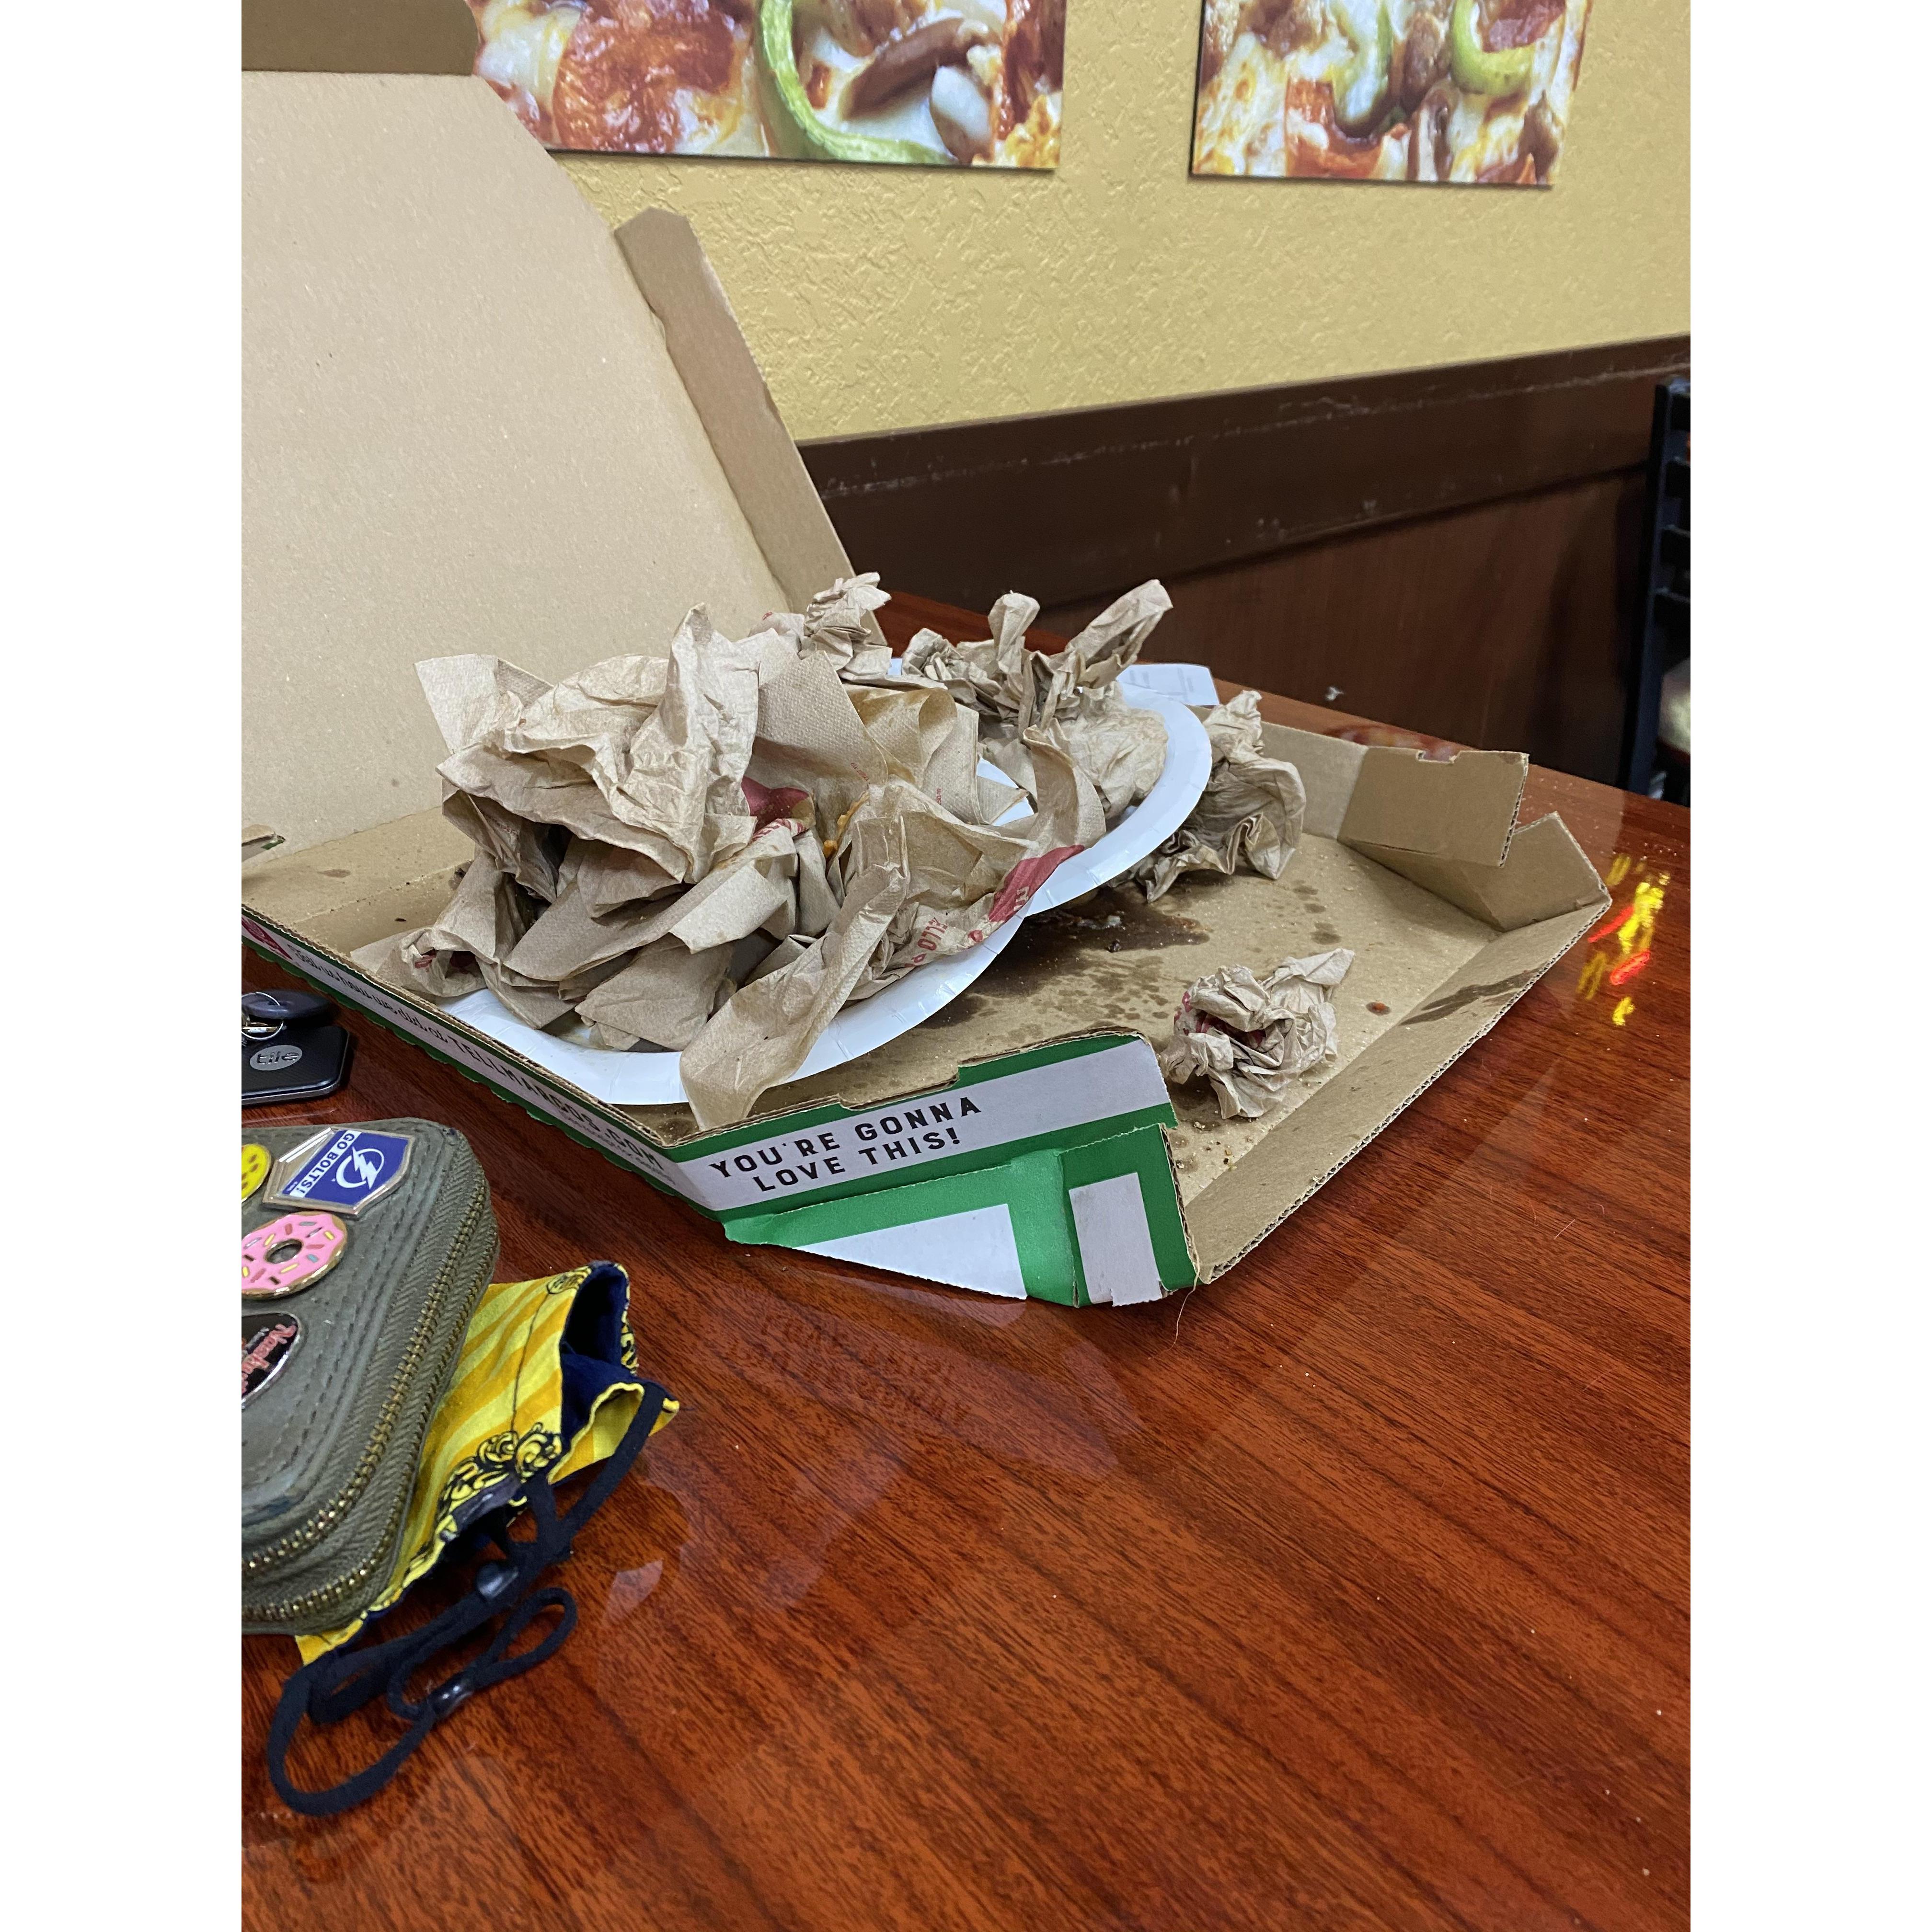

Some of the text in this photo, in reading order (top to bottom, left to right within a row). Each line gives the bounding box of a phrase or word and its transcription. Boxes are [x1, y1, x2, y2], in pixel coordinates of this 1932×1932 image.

[397, 1007, 428, 1033] did
[428, 1026, 448, 1044] at
[256, 1050, 299, 1065] tile
[296, 1133, 355, 1194] GO BOLTS!
[709, 1132, 840, 1178] YOU'RE
[855, 1097, 982, 1141] GONNA
[752, 1127, 960, 1192] LOVE THIS!
